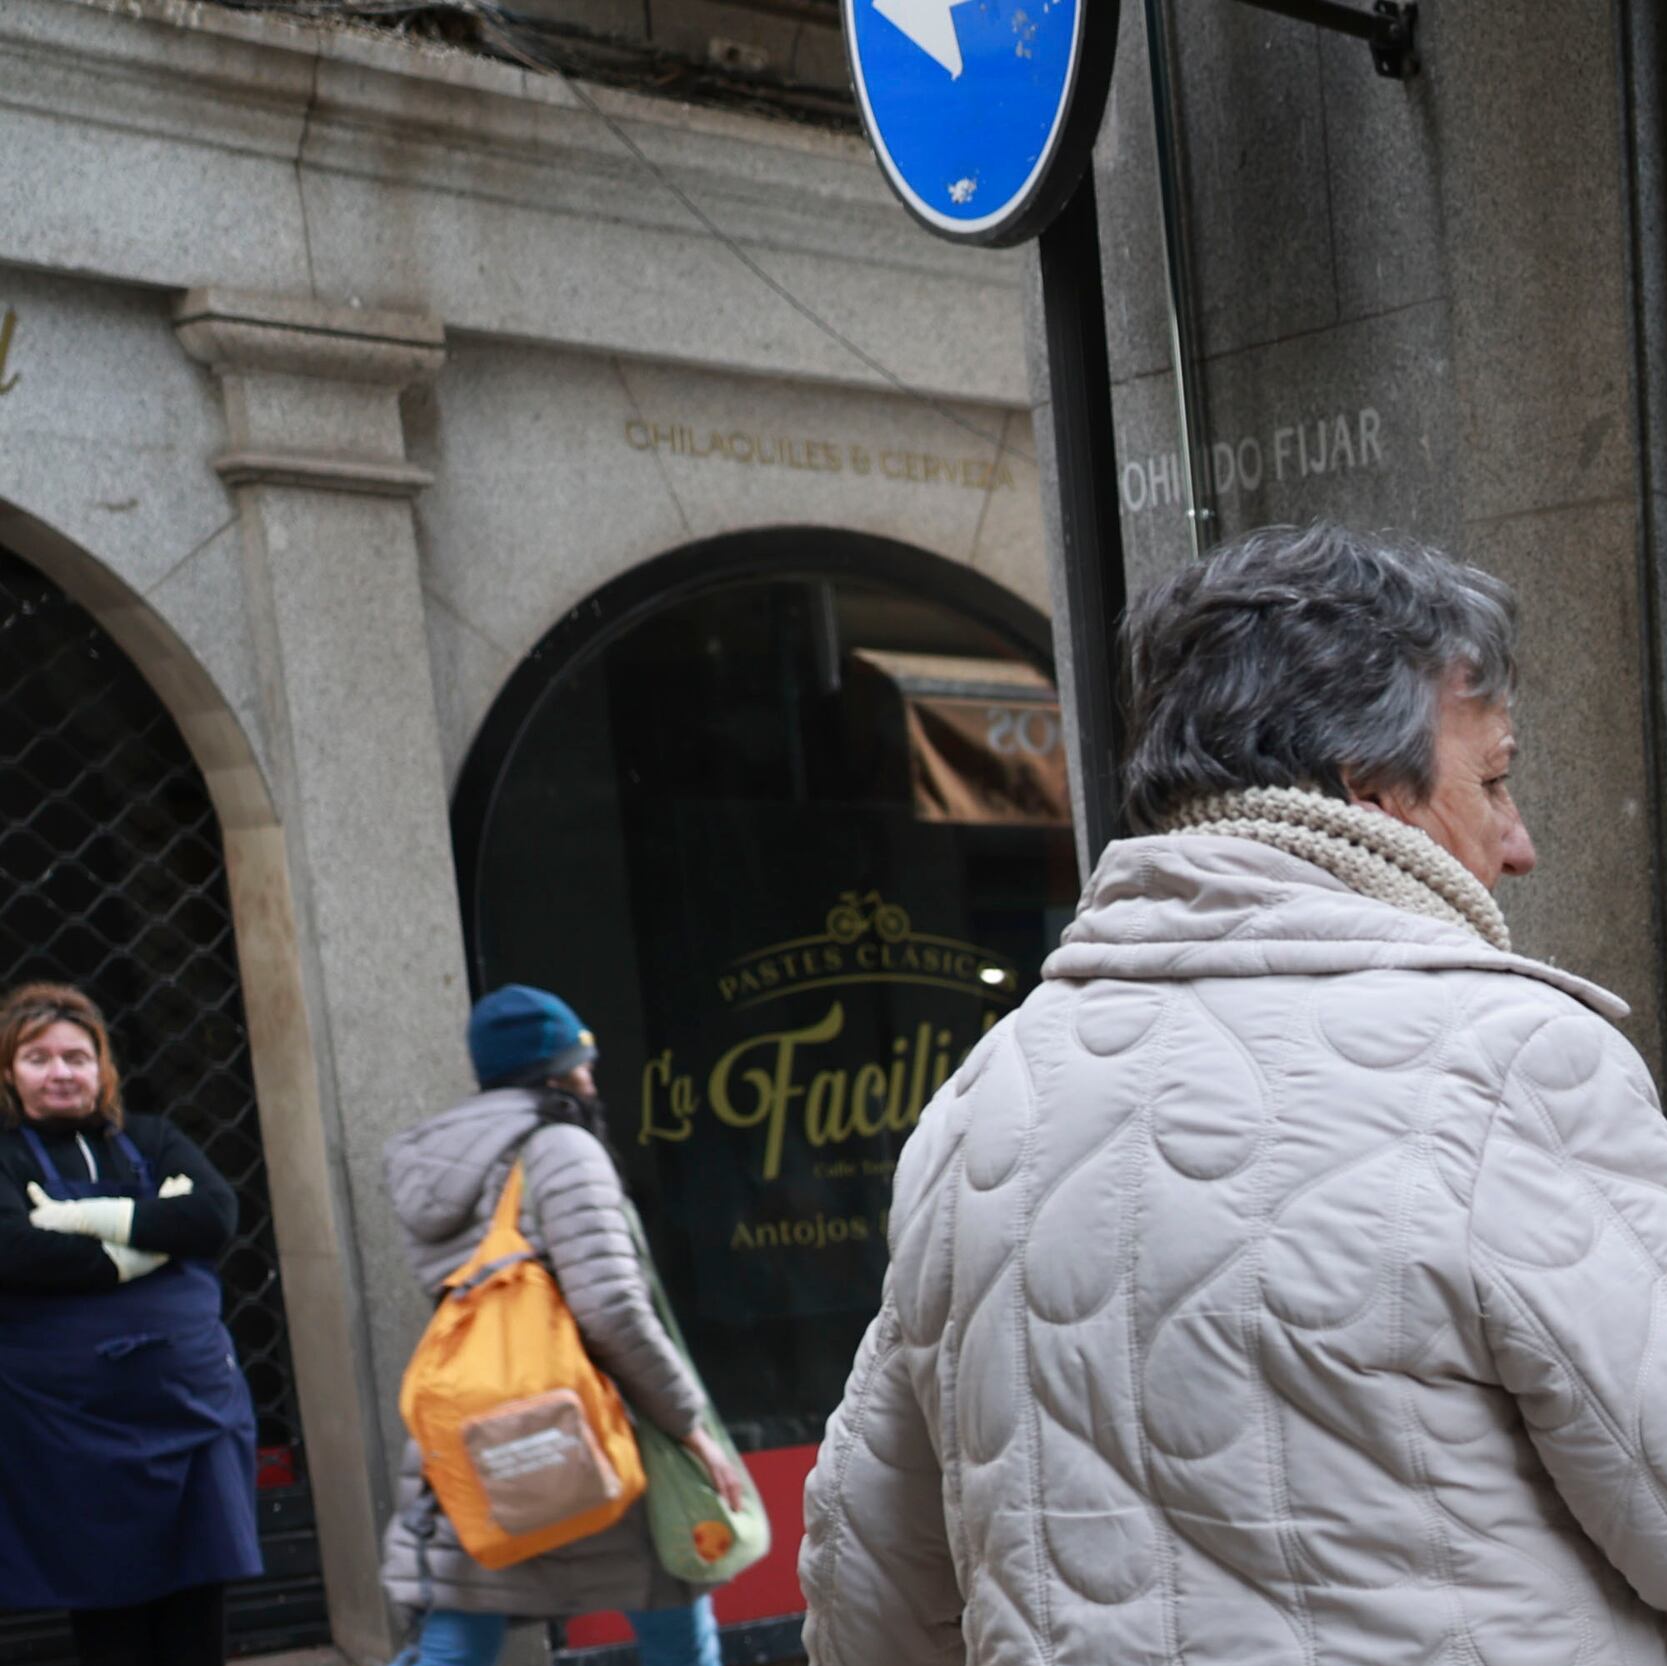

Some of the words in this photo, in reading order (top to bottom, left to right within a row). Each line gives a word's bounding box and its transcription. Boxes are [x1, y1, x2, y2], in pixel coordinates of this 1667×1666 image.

[624, 419, 842, 474] CHILAQUILES
[849, 444, 871, 475] &
[879, 451, 1017, 492] CERVEZA
[1274, 406, 1383, 480] FIJAR
[718, 945, 843, 1001] PASTES
[637, 1049, 698, 1146] La
[730, 1212, 869, 1250] Antojos
